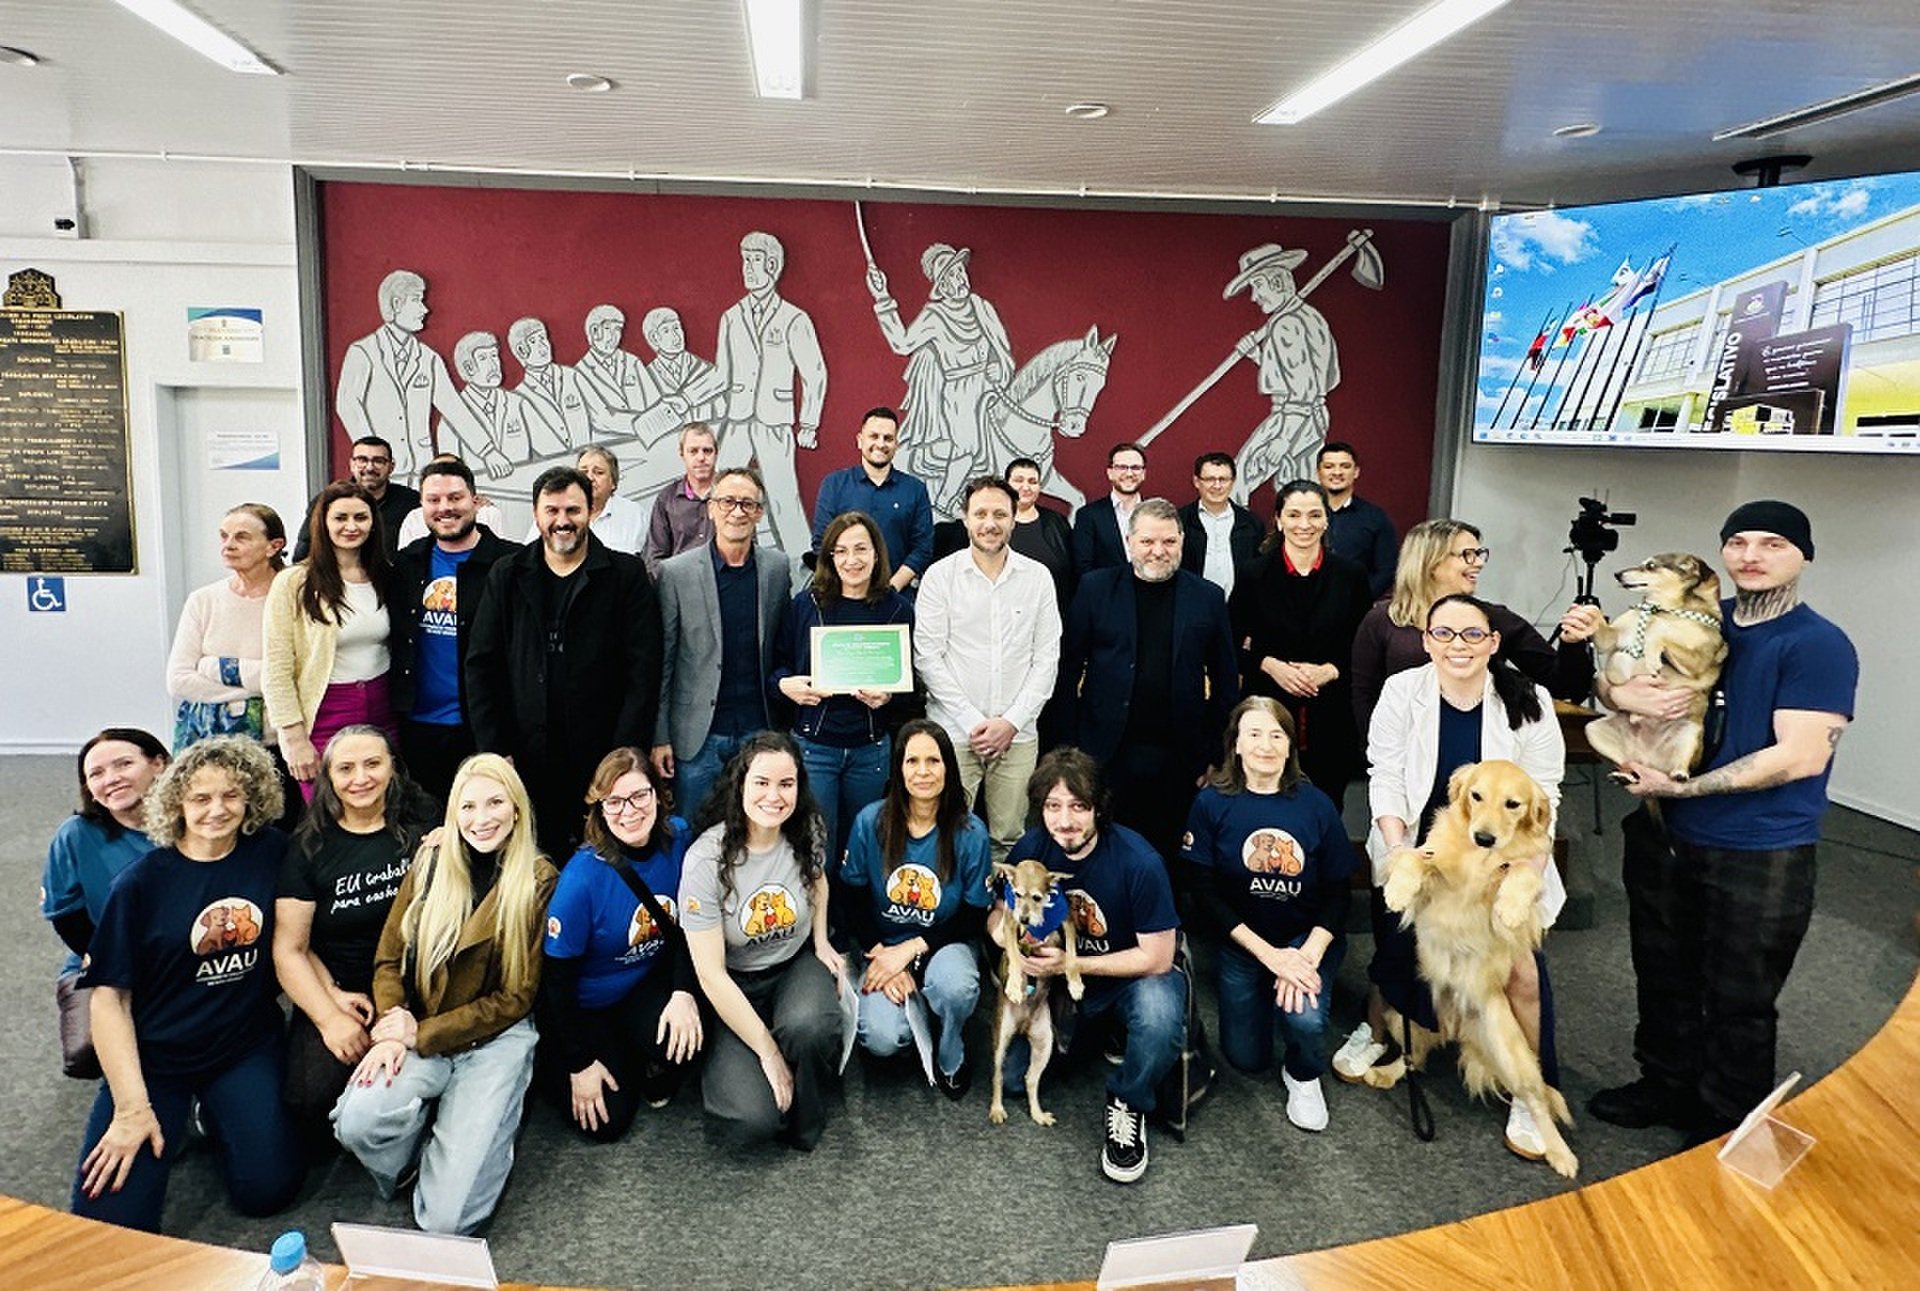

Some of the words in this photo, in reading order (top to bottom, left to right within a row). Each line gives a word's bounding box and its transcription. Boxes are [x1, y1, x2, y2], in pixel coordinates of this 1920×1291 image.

[335, 872, 361, 895] EU
[1249, 877, 1302, 895] AVAU
[330, 897, 361, 914] para
[887, 904, 935, 922] AVAU
[746, 926, 795, 946] AVAU
[1075, 936, 1110, 953] VAU
[196, 948, 258, 977] AVAU
